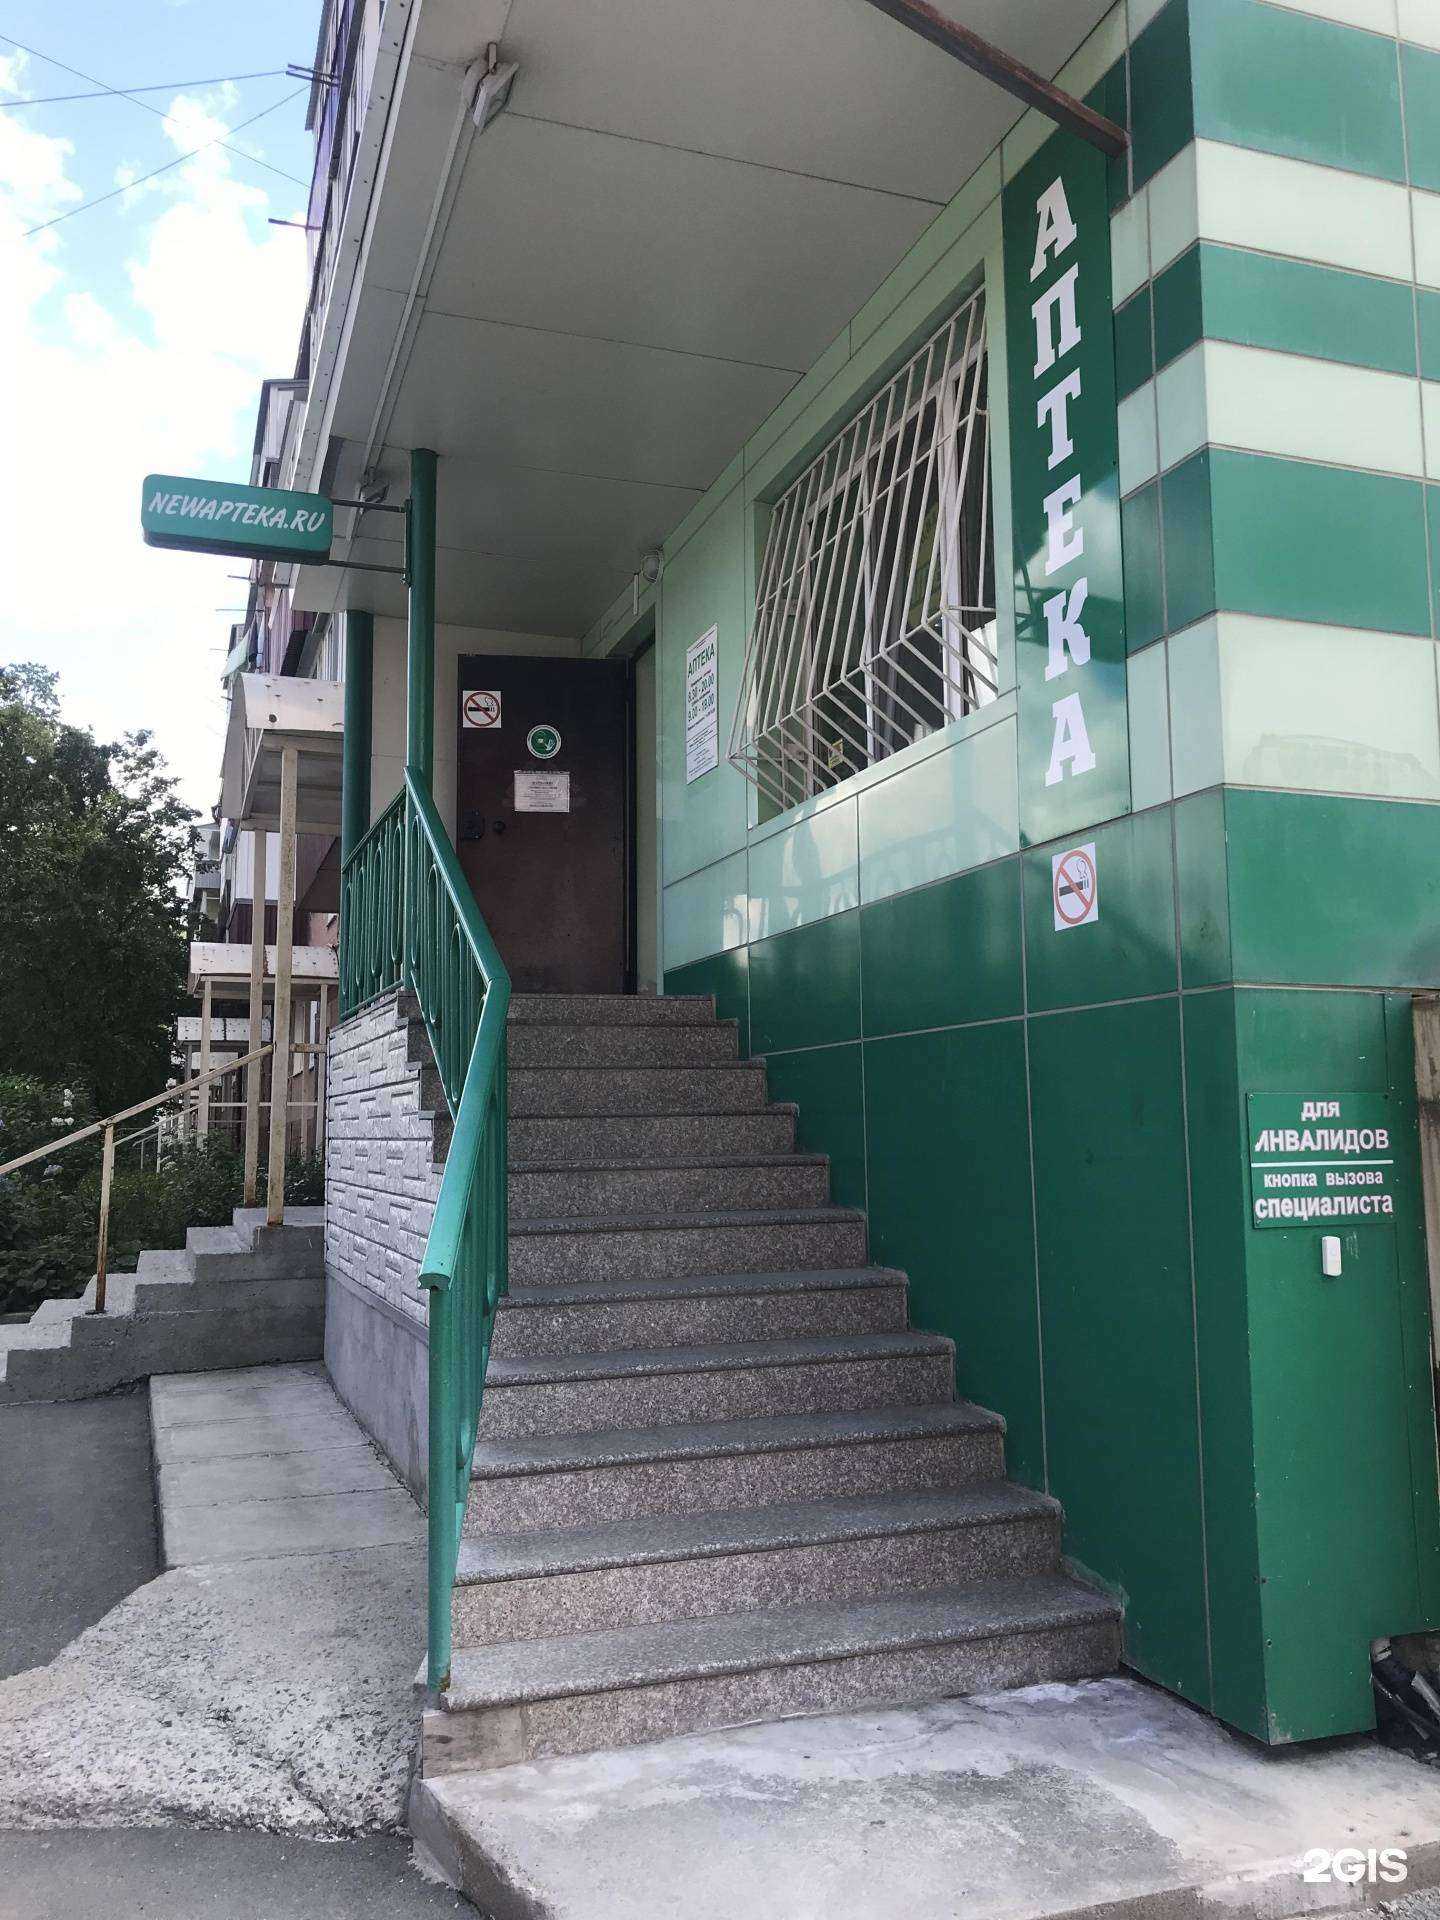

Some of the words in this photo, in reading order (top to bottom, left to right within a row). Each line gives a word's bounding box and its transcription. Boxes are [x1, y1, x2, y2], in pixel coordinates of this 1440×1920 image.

[1030, 176, 1096, 787] АПТЕКА
[148, 491, 326, 532] NEWAPTEKA.RU
[687, 642, 715, 679] АПТЕКА
[1263, 1172, 1318, 1188] кнопка
[1325, 1171, 1384, 1186] вызова
[1254, 1194, 1394, 1221] специалиста
